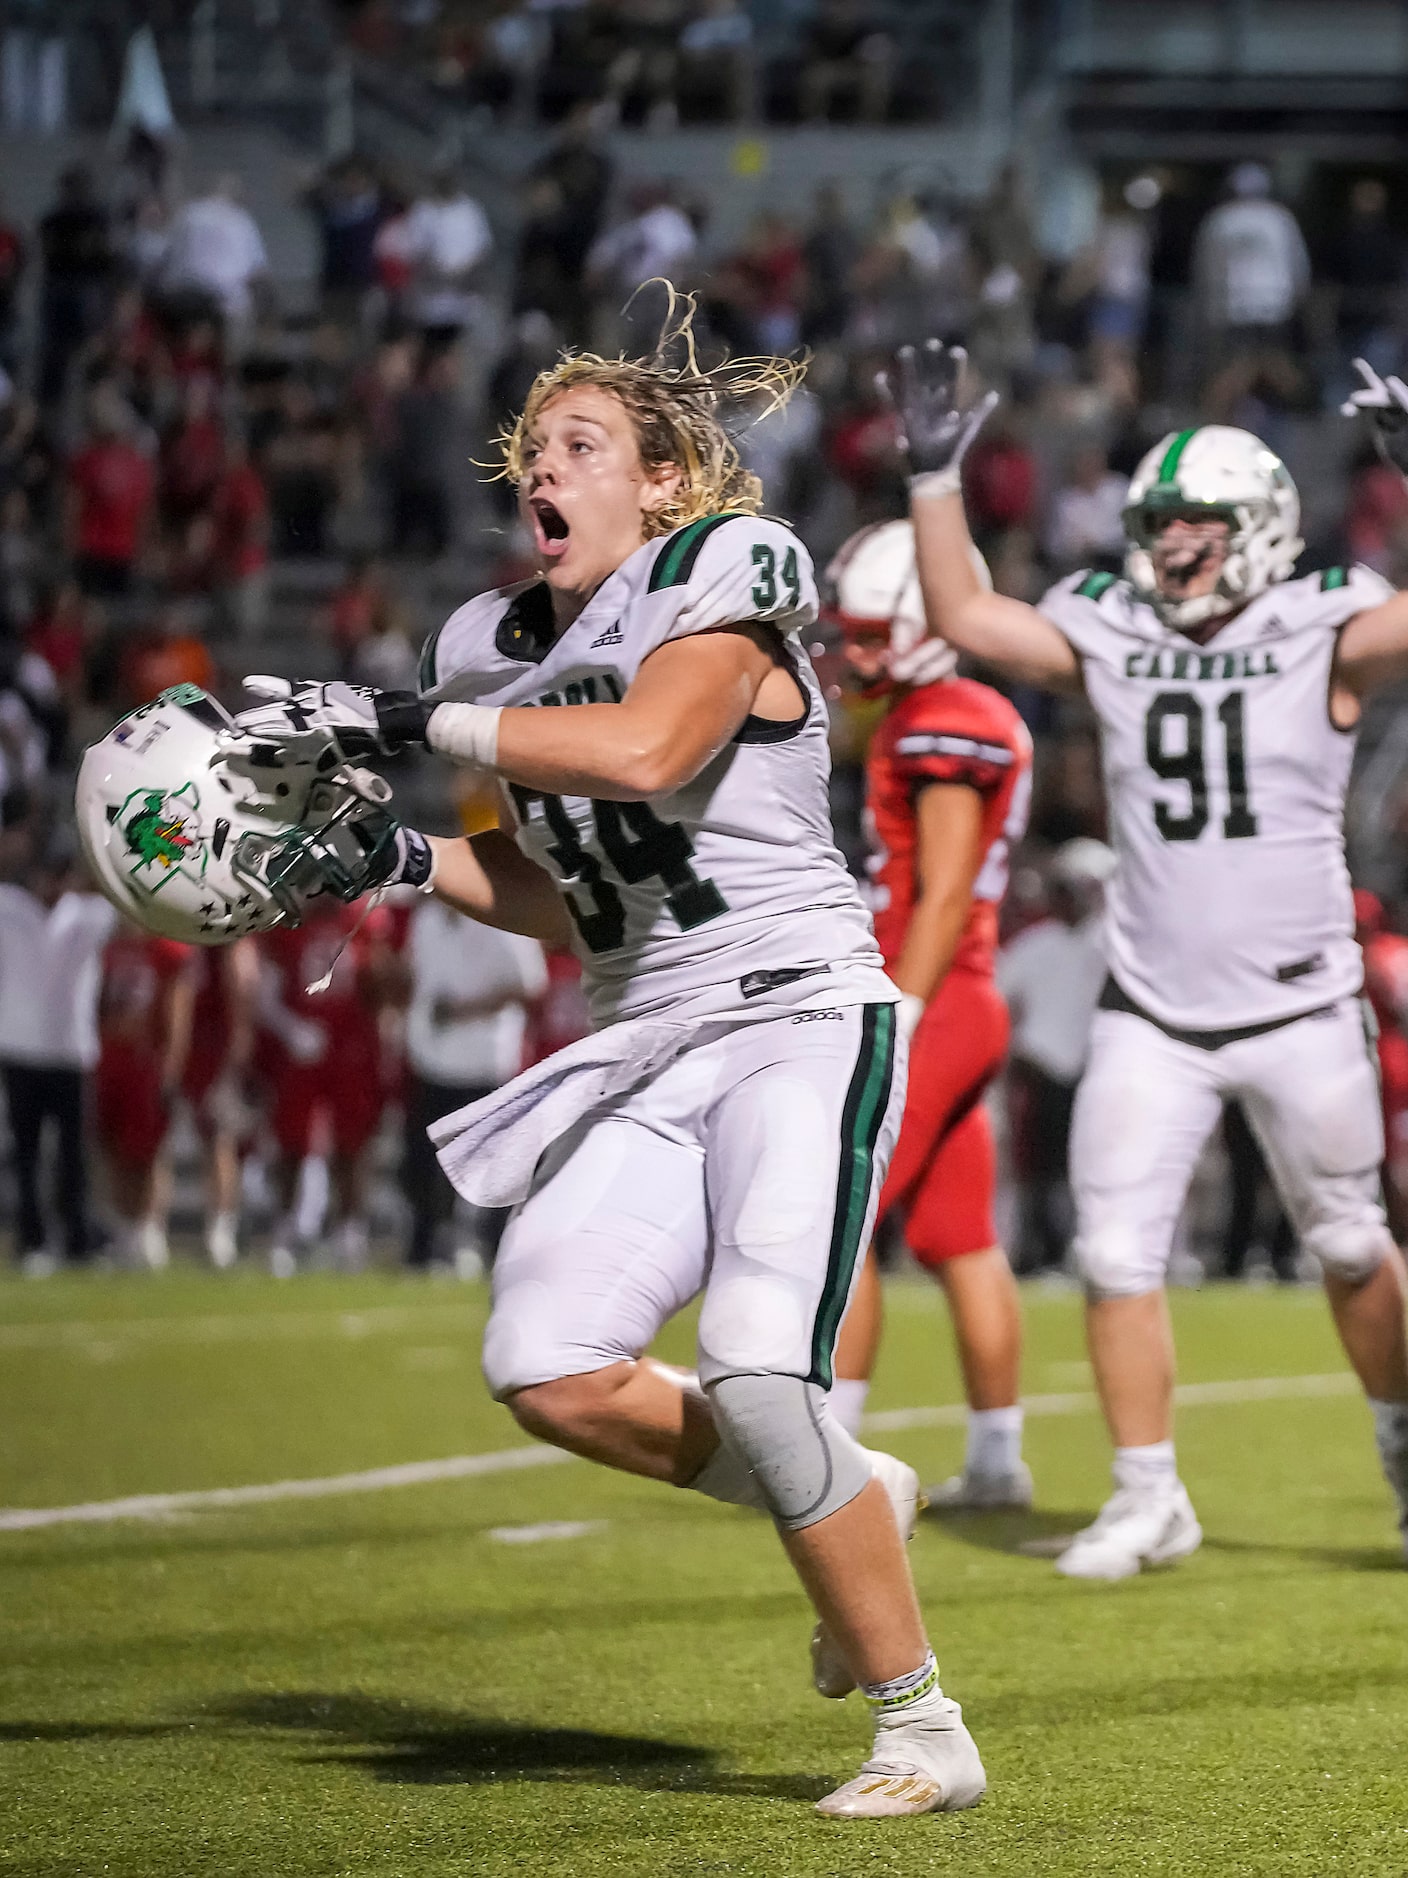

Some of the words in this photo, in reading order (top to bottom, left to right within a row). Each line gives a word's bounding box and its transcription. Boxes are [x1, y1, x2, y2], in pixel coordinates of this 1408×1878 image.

[750, 543, 801, 610] 34
[1145, 692, 1258, 842] 91
[507, 782, 732, 954] 34
